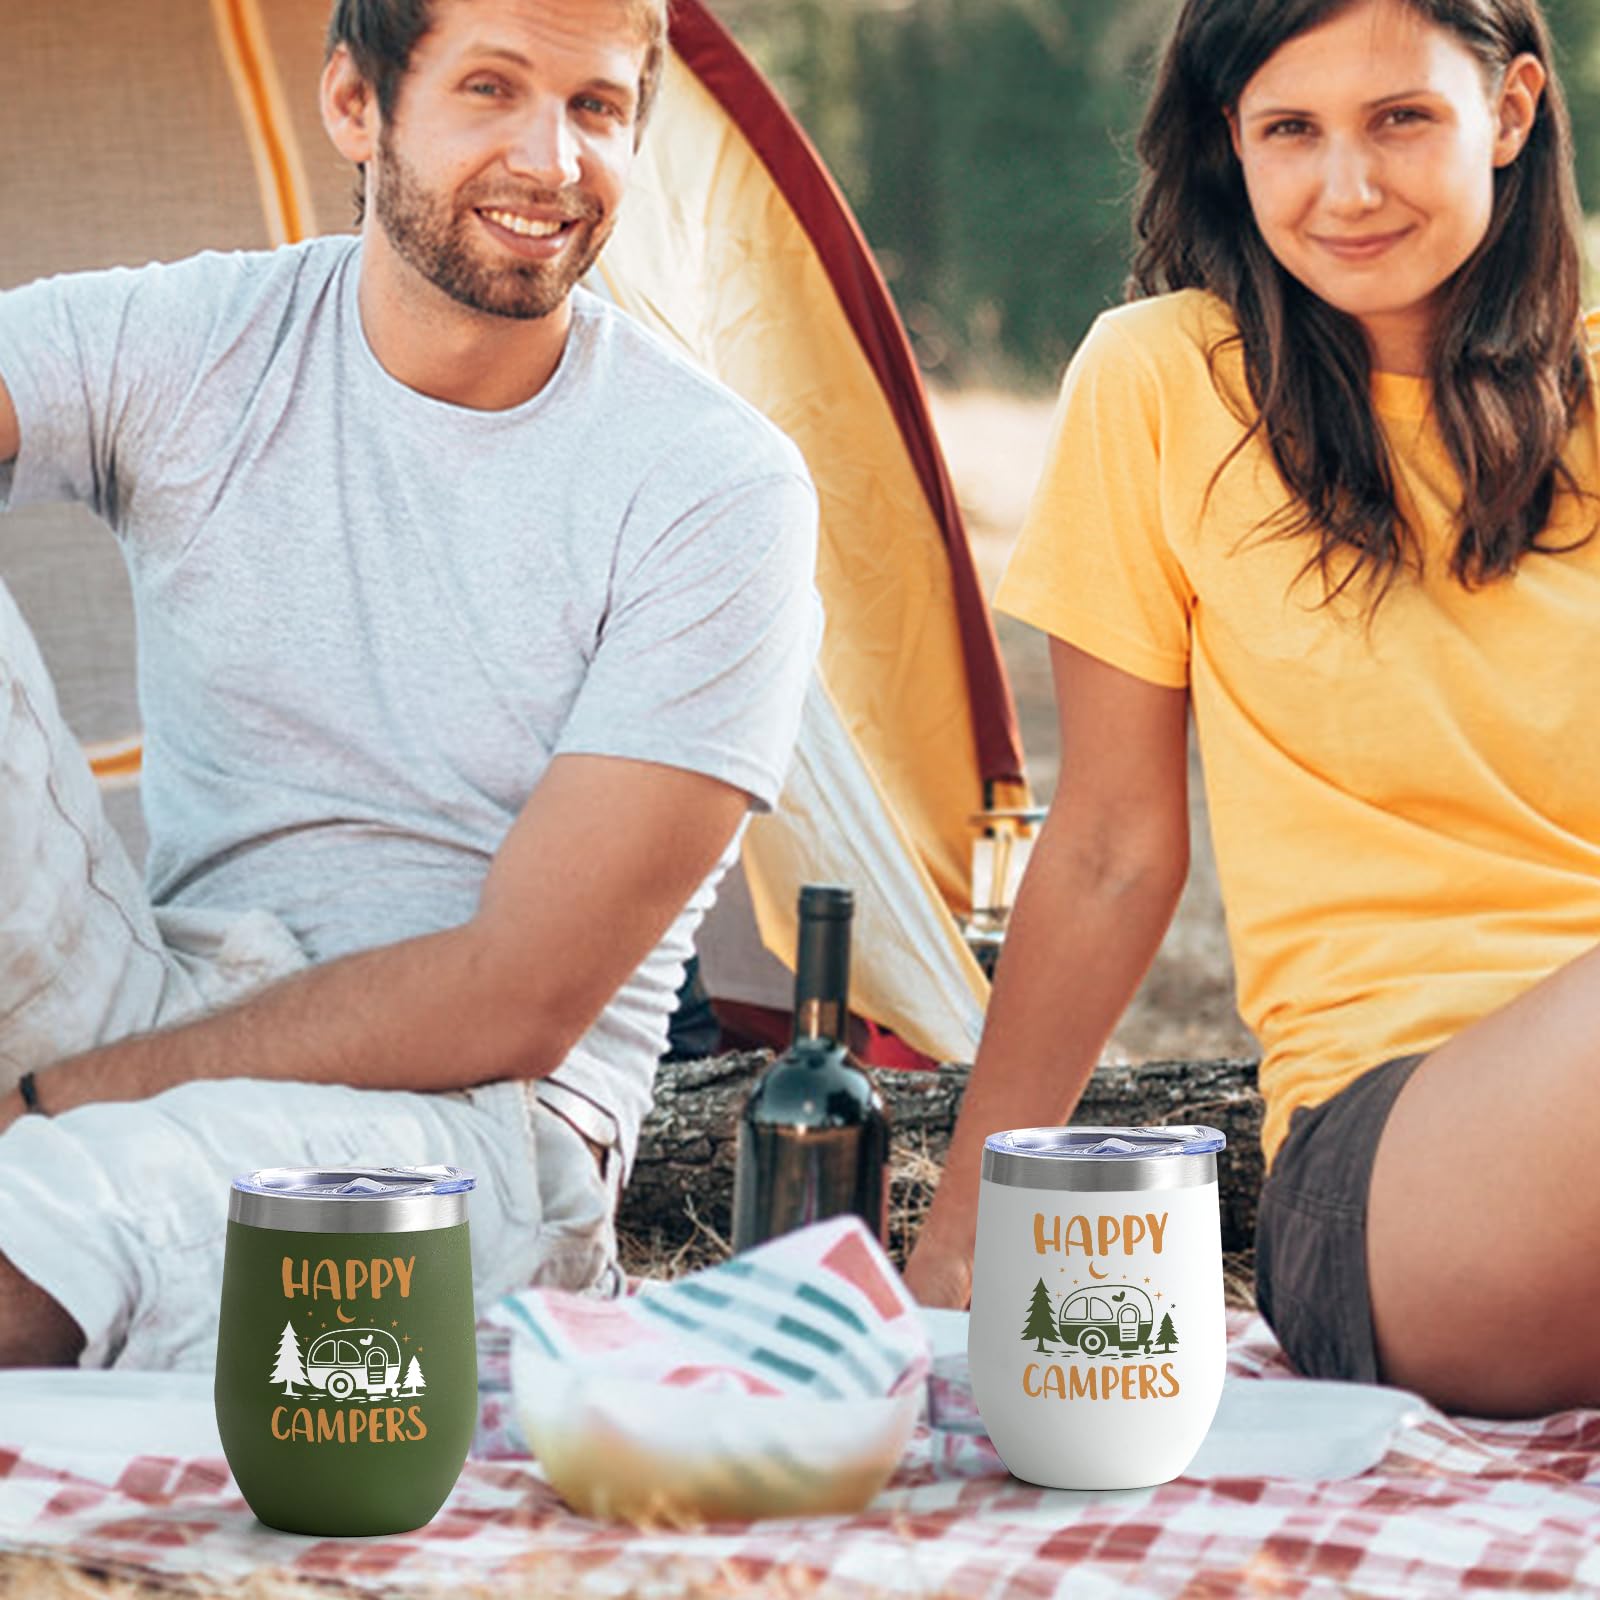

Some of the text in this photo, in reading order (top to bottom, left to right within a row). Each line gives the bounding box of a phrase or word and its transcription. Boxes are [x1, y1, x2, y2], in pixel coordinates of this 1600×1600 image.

[1033, 1212, 1168, 1256] HAPPY
[281, 1256, 416, 1300] HAPPY
[1022, 1363, 1180, 1401] CAMPERS
[270, 1405, 428, 1444] CAMPERS
